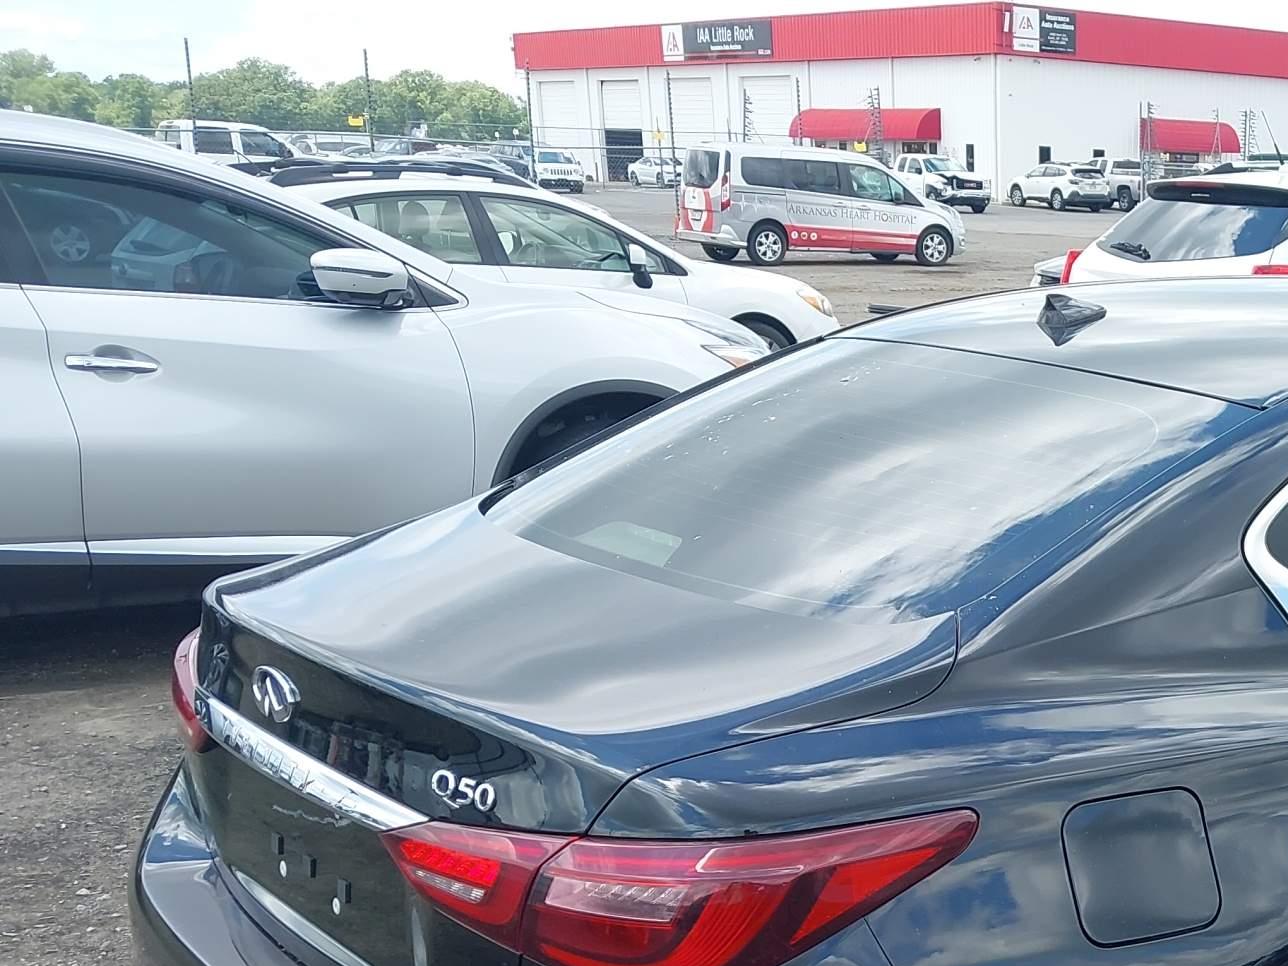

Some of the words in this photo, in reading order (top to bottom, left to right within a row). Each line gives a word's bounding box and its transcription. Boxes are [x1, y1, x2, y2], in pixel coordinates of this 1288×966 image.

[696, 27, 710, 43] IAA
[711, 26, 732, 42] Little
[733, 25, 755, 41] Rock
[788, 203, 838, 217] ARKANSAS
[841, 208, 871, 220] HEART
[431, 769, 497, 812] Q50
